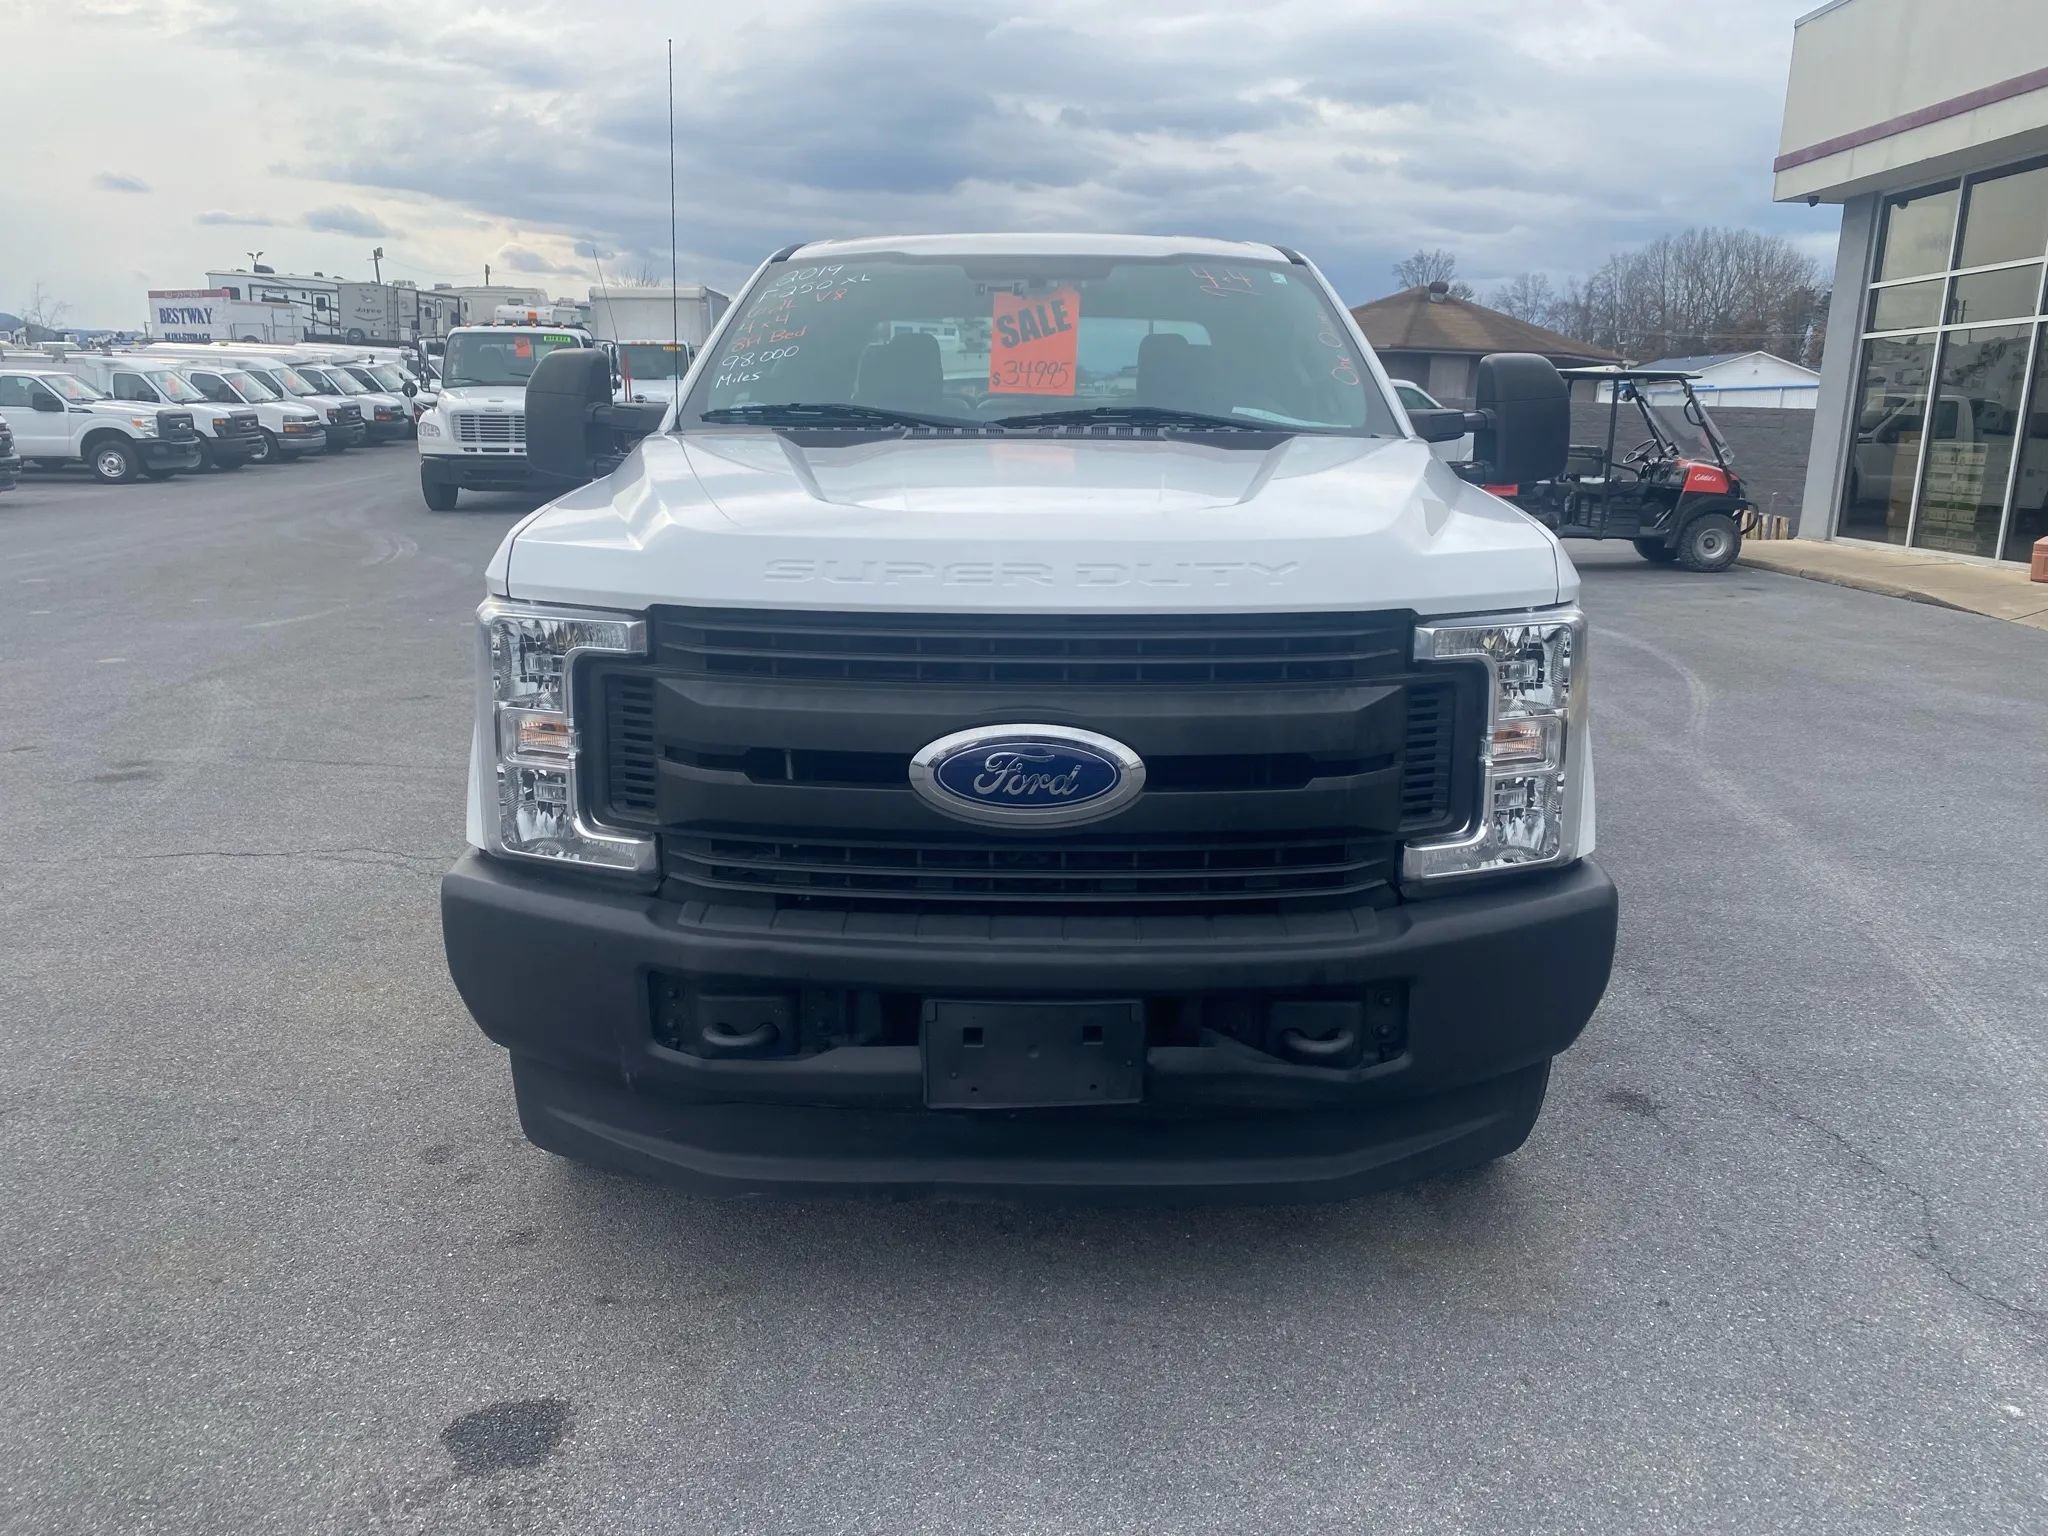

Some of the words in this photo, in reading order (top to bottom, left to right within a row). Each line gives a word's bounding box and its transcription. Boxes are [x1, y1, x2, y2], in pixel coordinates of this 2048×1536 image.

[776, 264, 844, 287] 2019
[816, 288, 848, 302] V8
[159, 307, 212, 324] BESTWAY
[996, 300, 1072, 348] SALE
[769, 325, 807, 343] Bed
[716, 371, 761, 389] Miles
[763, 558, 1055, 586] SUPER
[1076, 560, 1300, 587] DUTY
[973, 751, 1082, 796] Ford
